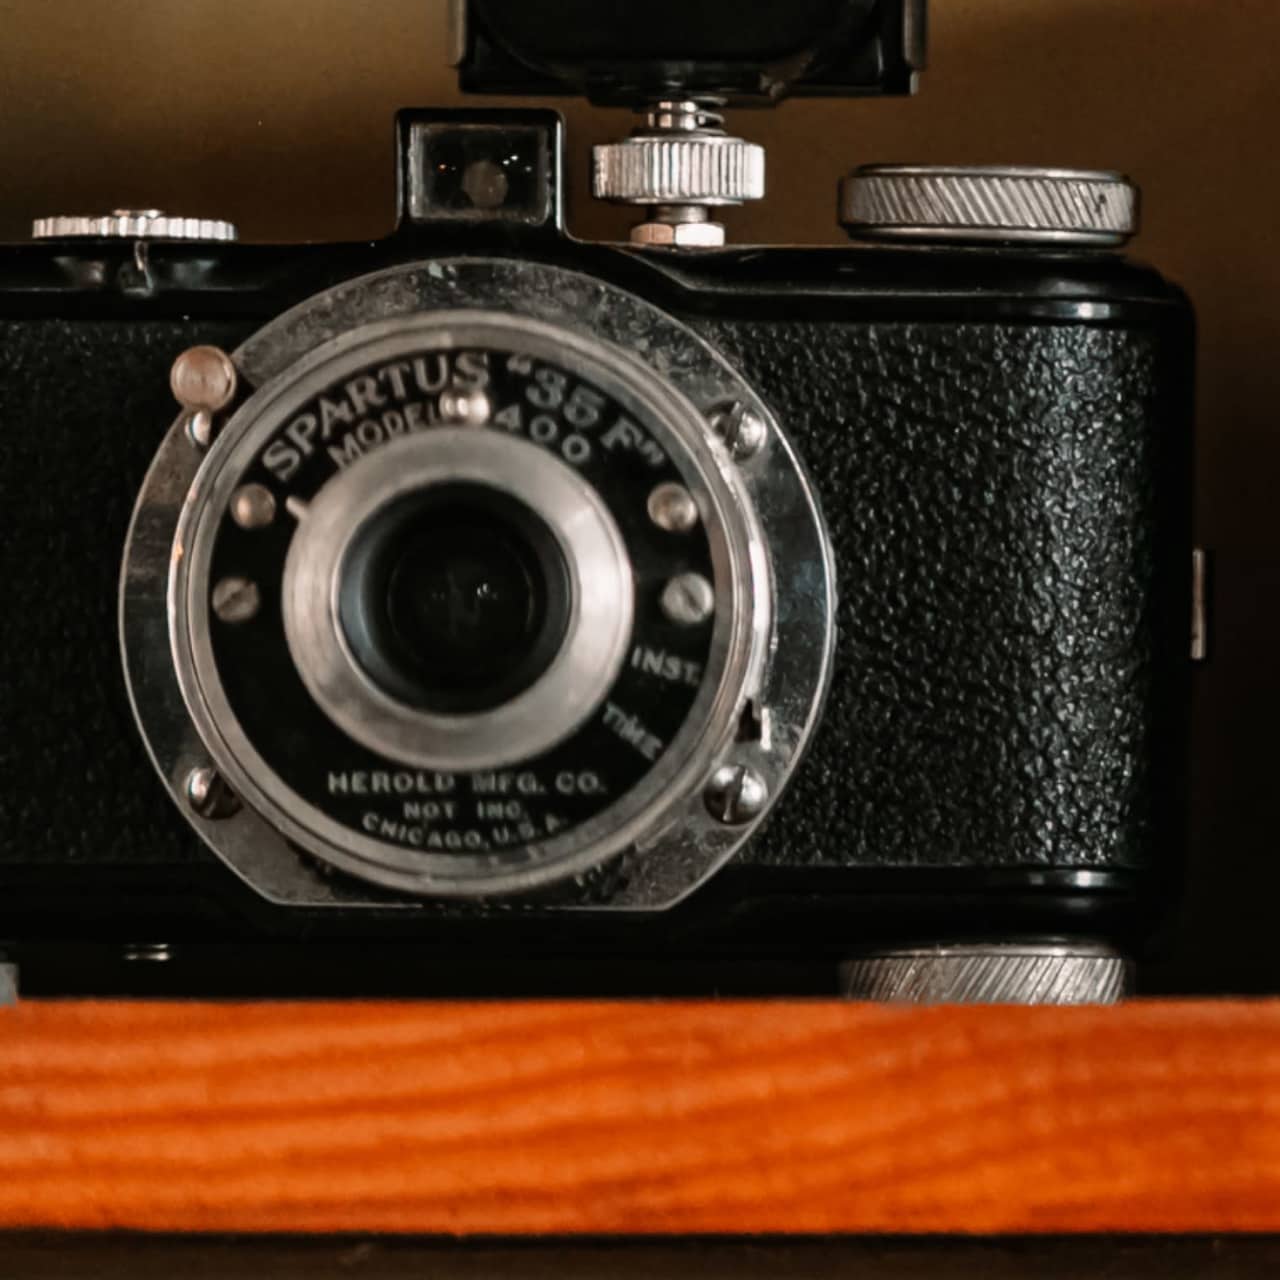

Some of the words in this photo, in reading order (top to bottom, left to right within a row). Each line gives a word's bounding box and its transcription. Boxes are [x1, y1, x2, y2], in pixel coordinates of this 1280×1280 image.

[262, 352, 488, 481] SPARTUS
[495, 403, 591, 463] 400
[327, 772, 456, 795] HEROLD
[403, 800, 457, 819] NOT
